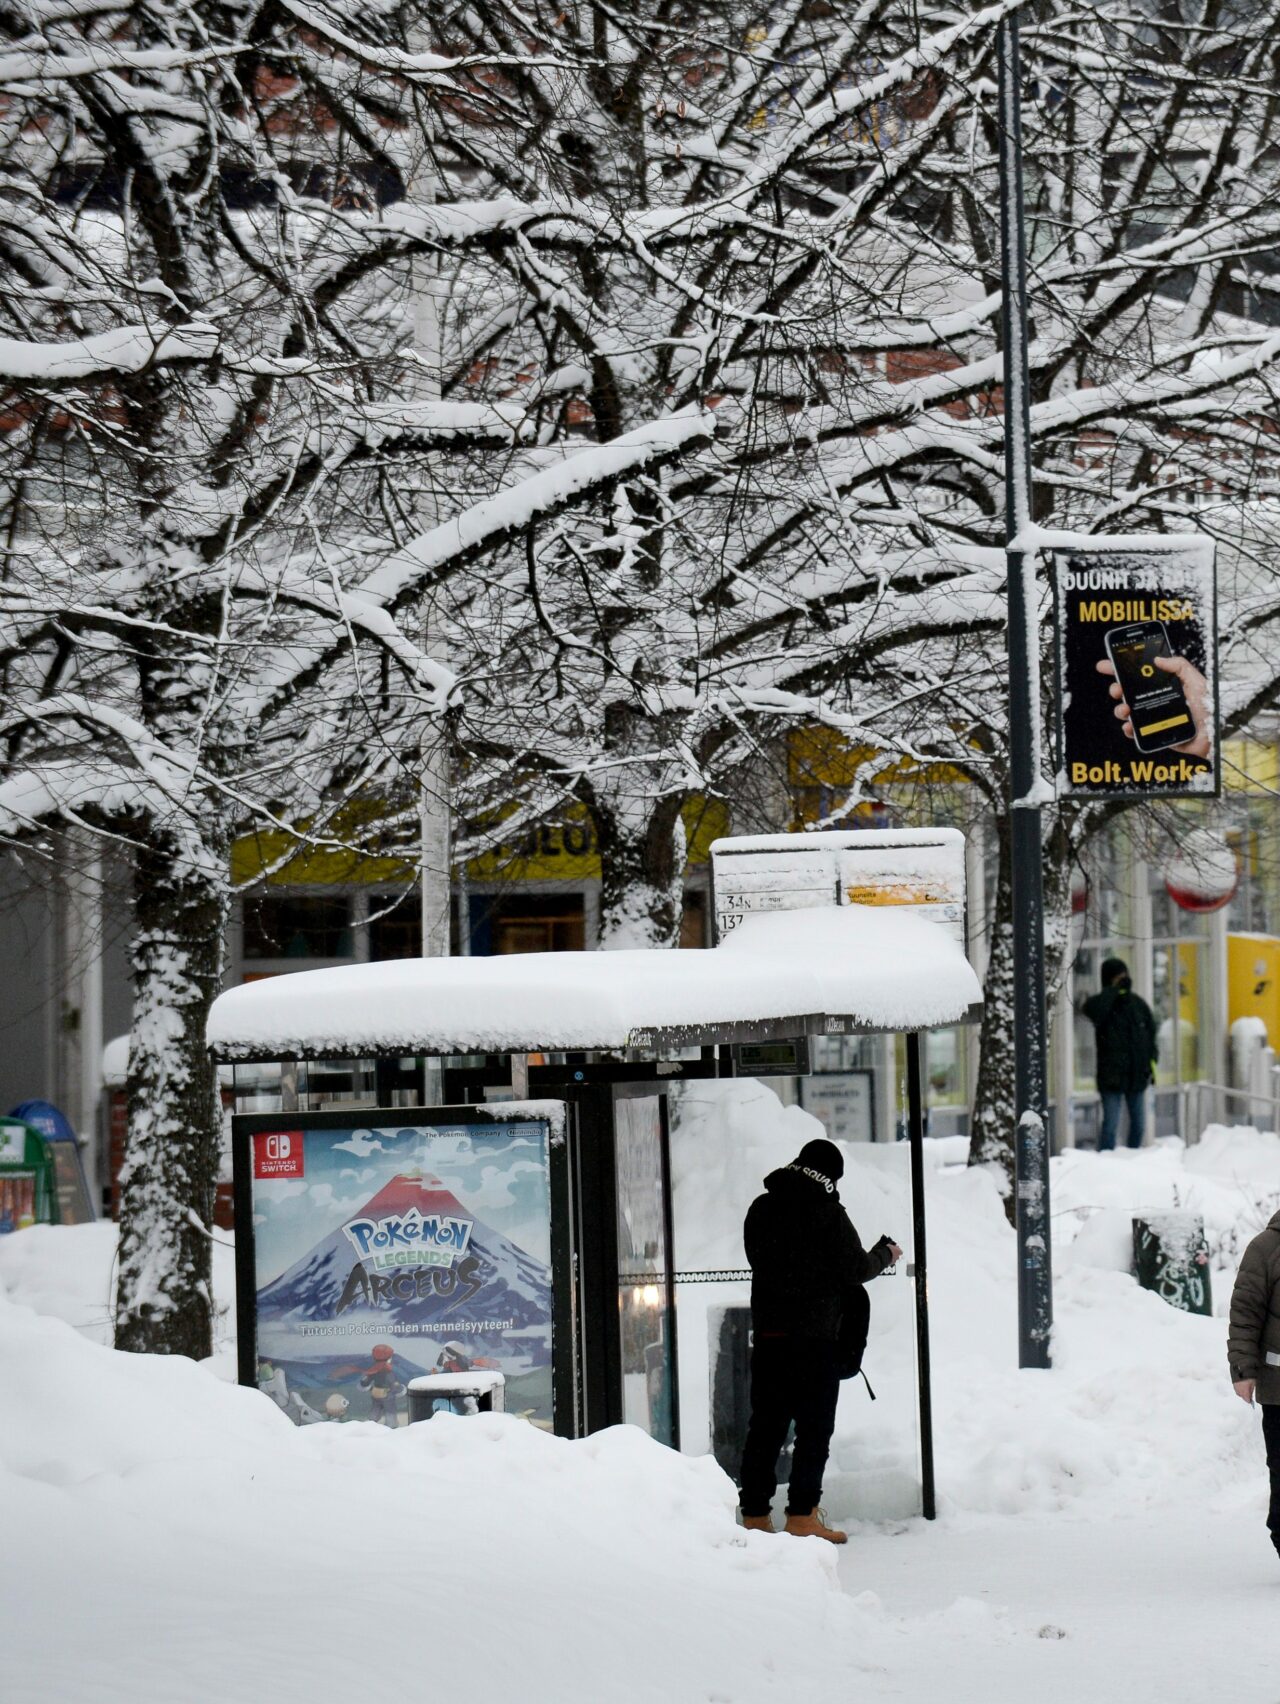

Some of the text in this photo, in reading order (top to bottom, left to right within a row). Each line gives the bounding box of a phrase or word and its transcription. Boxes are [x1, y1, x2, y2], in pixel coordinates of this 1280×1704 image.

[1079, 599, 1194, 623] MOBIILISSA
[1072, 759, 1210, 784] Bolt.Works
[803, 1167, 834, 1194] SQUAD
[375, 1250, 453, 1268] LEGENDS
[335, 1256, 483, 1315] ARCEUS
[300, 1318, 514, 1337] Tutustu Pokémonien menneisyyteen!
